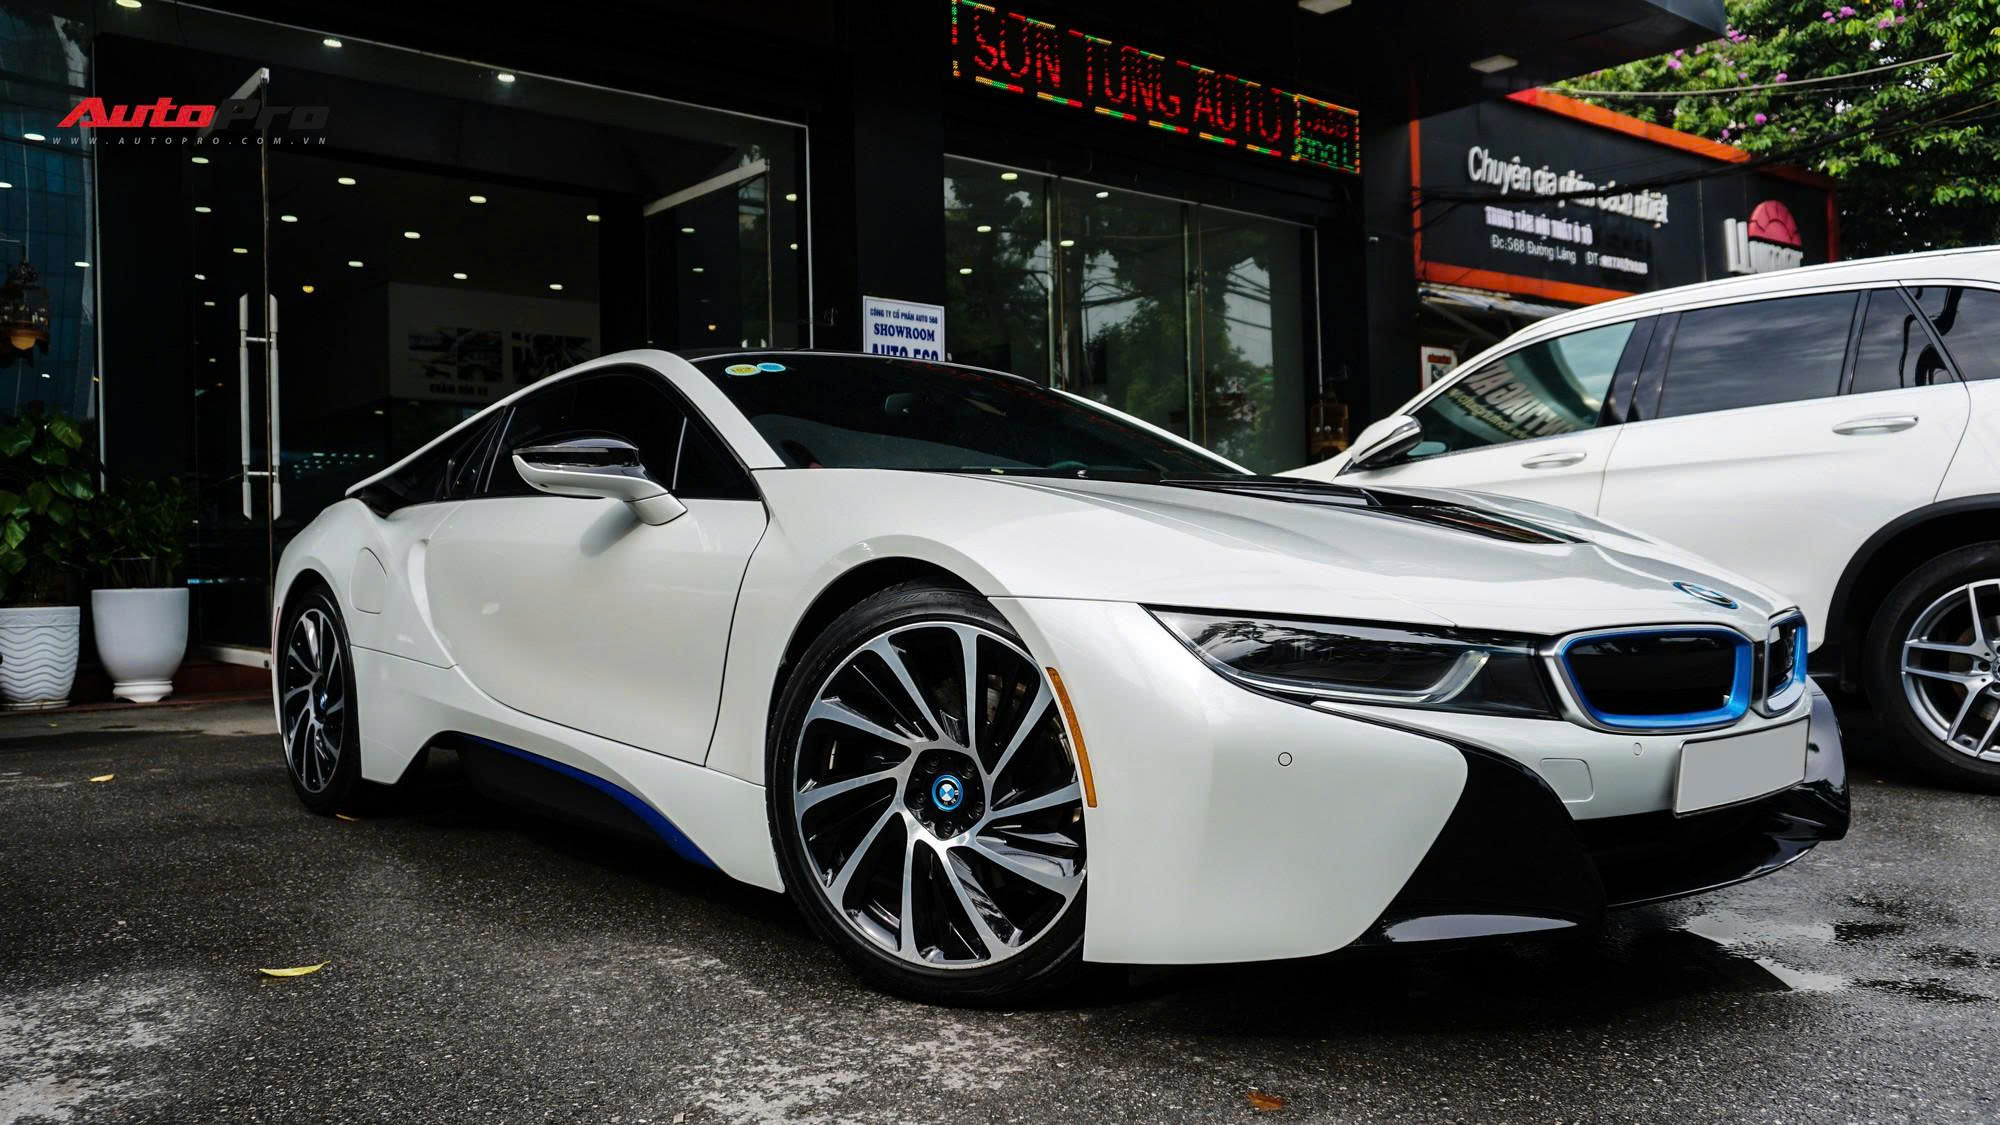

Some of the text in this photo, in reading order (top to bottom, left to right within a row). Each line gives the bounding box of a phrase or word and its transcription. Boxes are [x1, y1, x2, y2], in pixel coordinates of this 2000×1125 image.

[1193, 70, 1283, 143] AUTO
[1467, 146, 1531, 195] Chuyên
[873, 323, 935, 341] SHOWROOM
